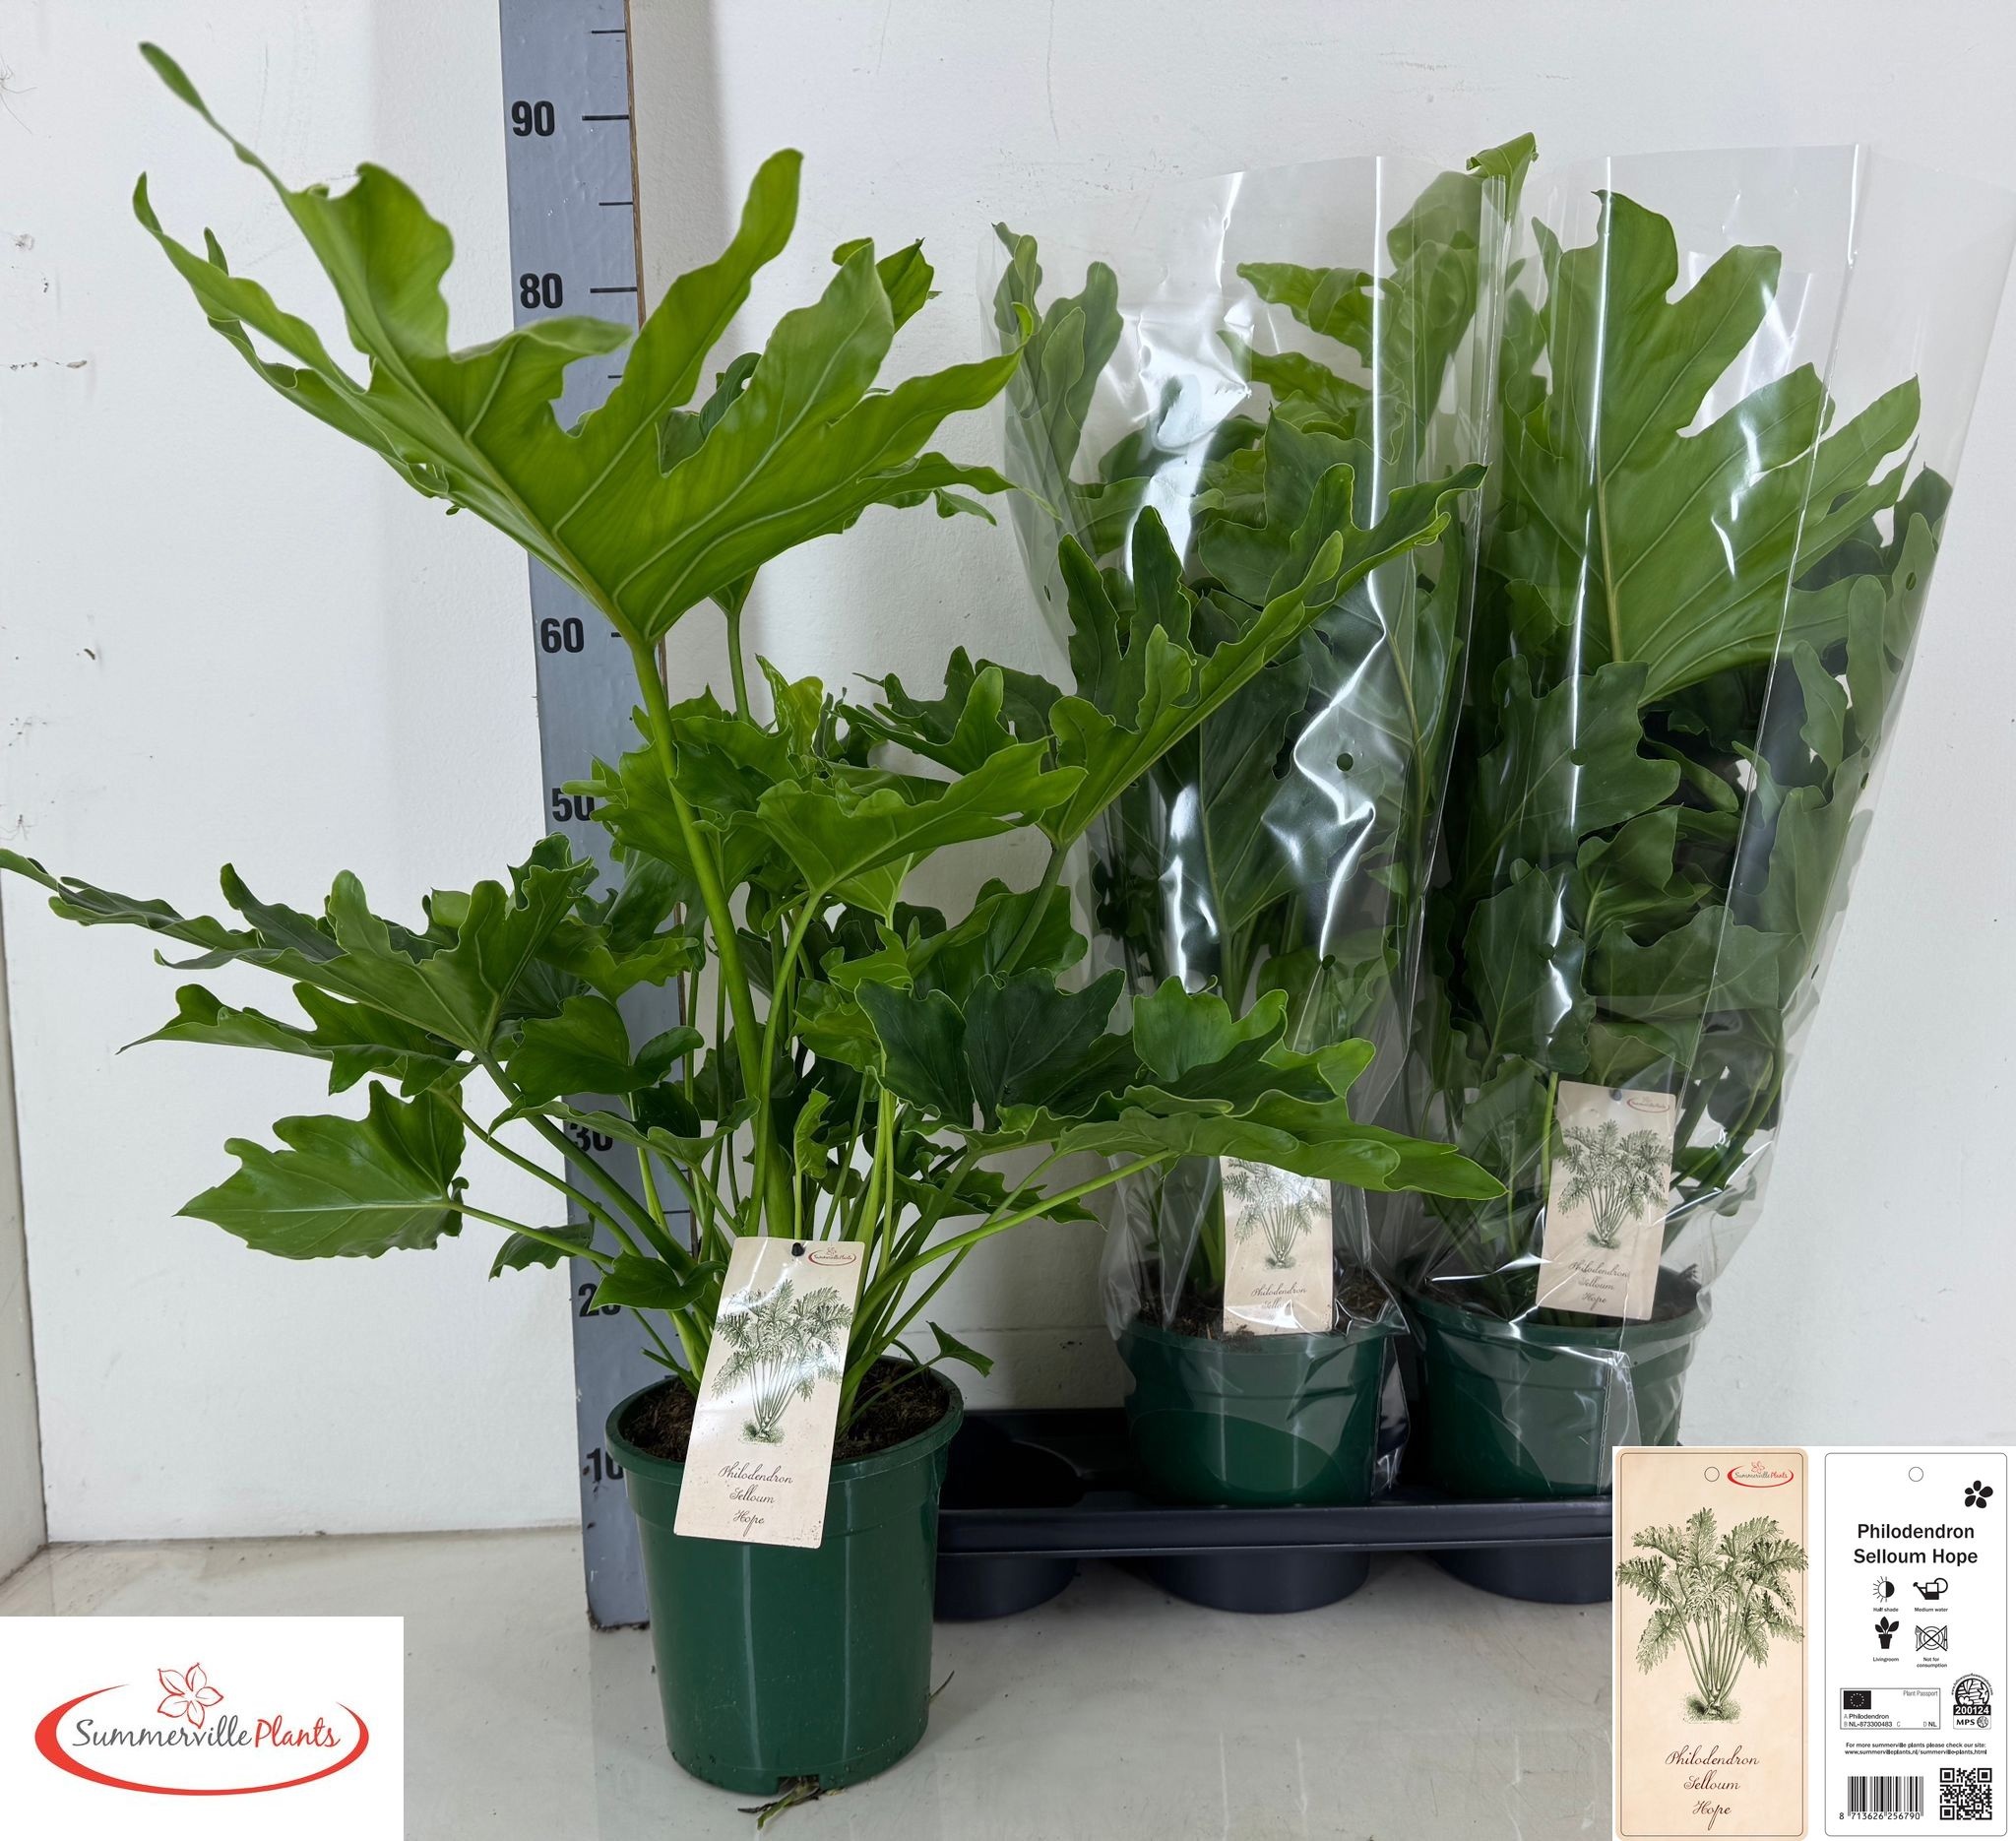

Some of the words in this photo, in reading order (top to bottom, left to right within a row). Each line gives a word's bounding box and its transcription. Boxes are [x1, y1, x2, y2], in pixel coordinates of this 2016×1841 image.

[512, 100, 555, 137] 90
[519, 272, 564, 309] 80
[540, 617, 584, 654] 60
[551, 787, 595, 822] 50
[1568, 1259, 1630, 1278] Philodendron
[1250, 1281, 1307, 1298] Philodendron
[1582, 1292, 1607, 1311] Hope
[718, 1460, 793, 1484] Philodendron
[729, 1483, 776, 1504] Selloum
[732, 1509, 765, 1537] Hope
